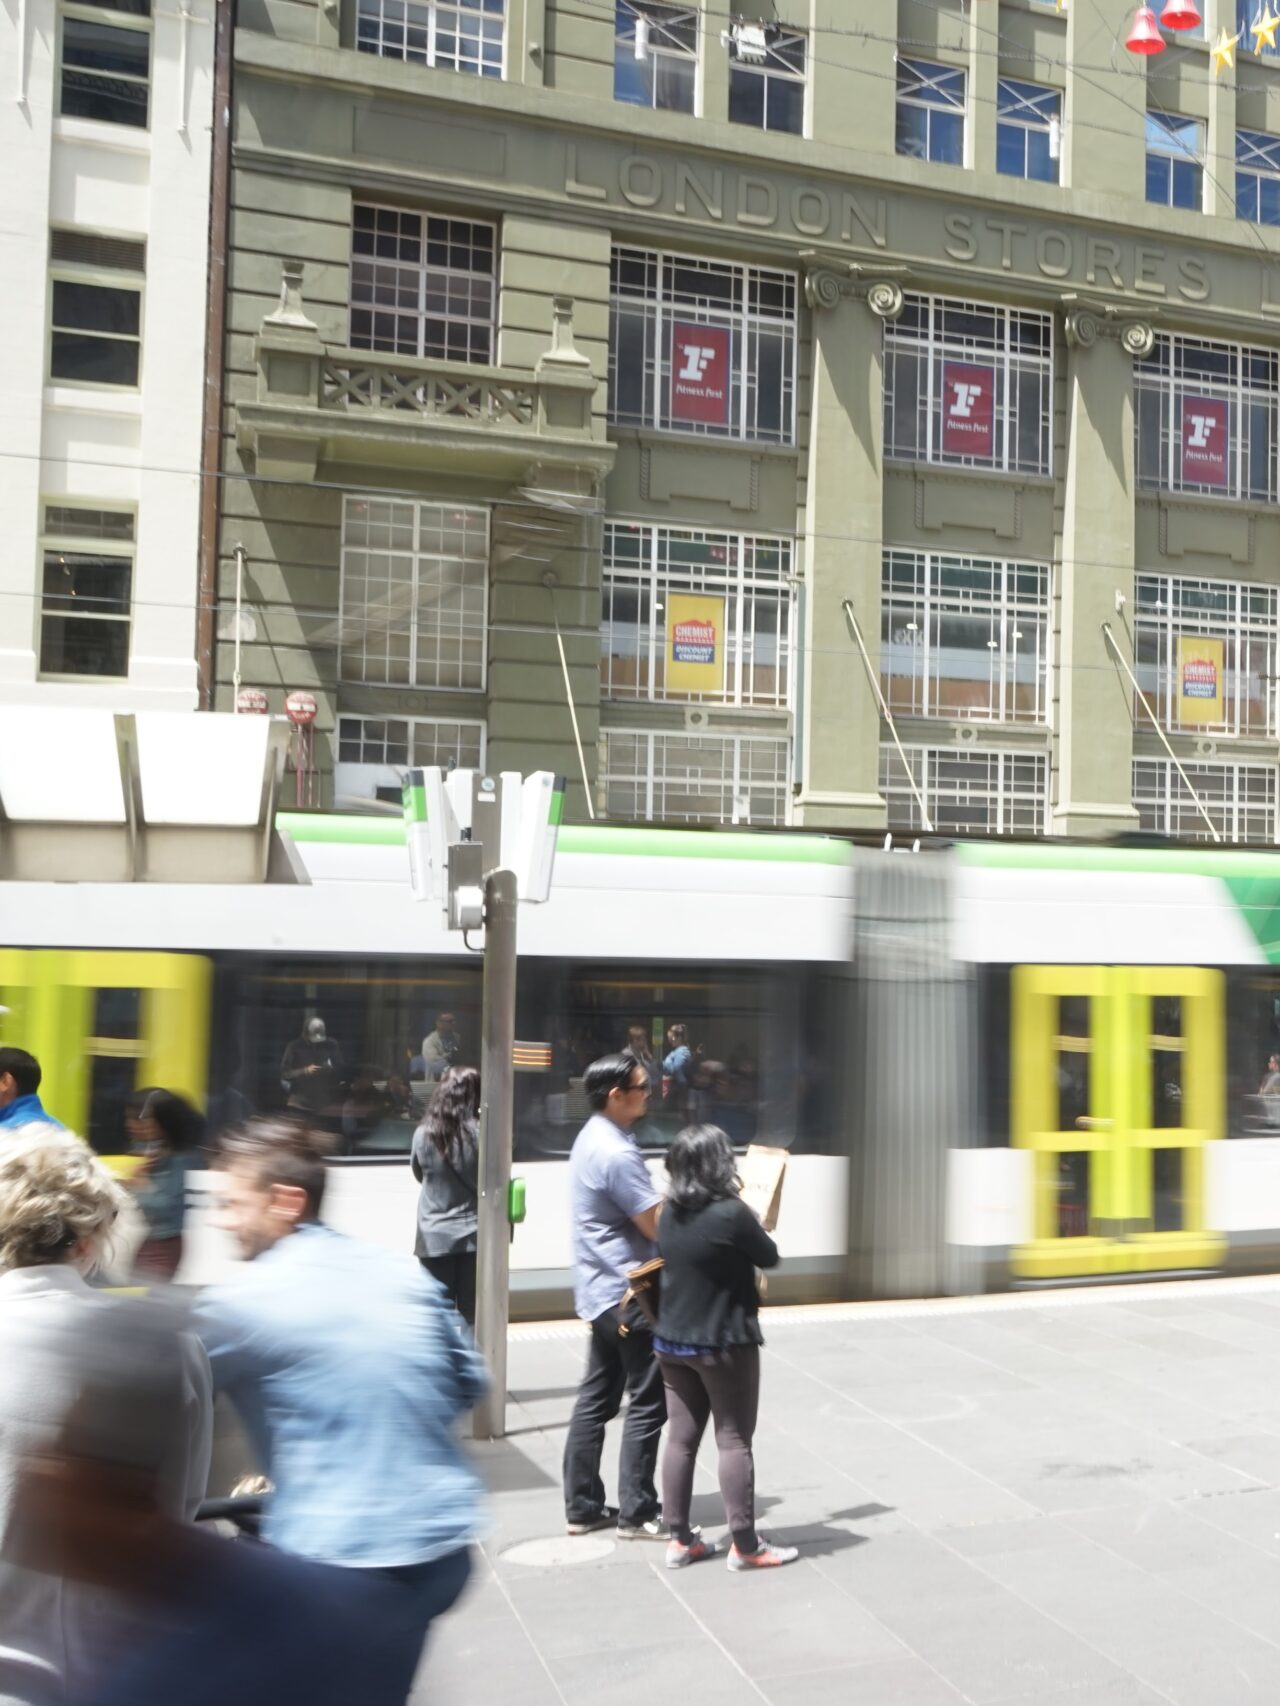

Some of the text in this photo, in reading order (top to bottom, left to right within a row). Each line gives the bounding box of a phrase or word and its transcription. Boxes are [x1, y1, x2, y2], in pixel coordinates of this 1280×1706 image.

[565, 144, 888, 247] LONDON
[943, 213, 1211, 300] STORES
[675, 624, 714, 640] CHEMIST
[1184, 663, 1215, 676] CHEMIST
